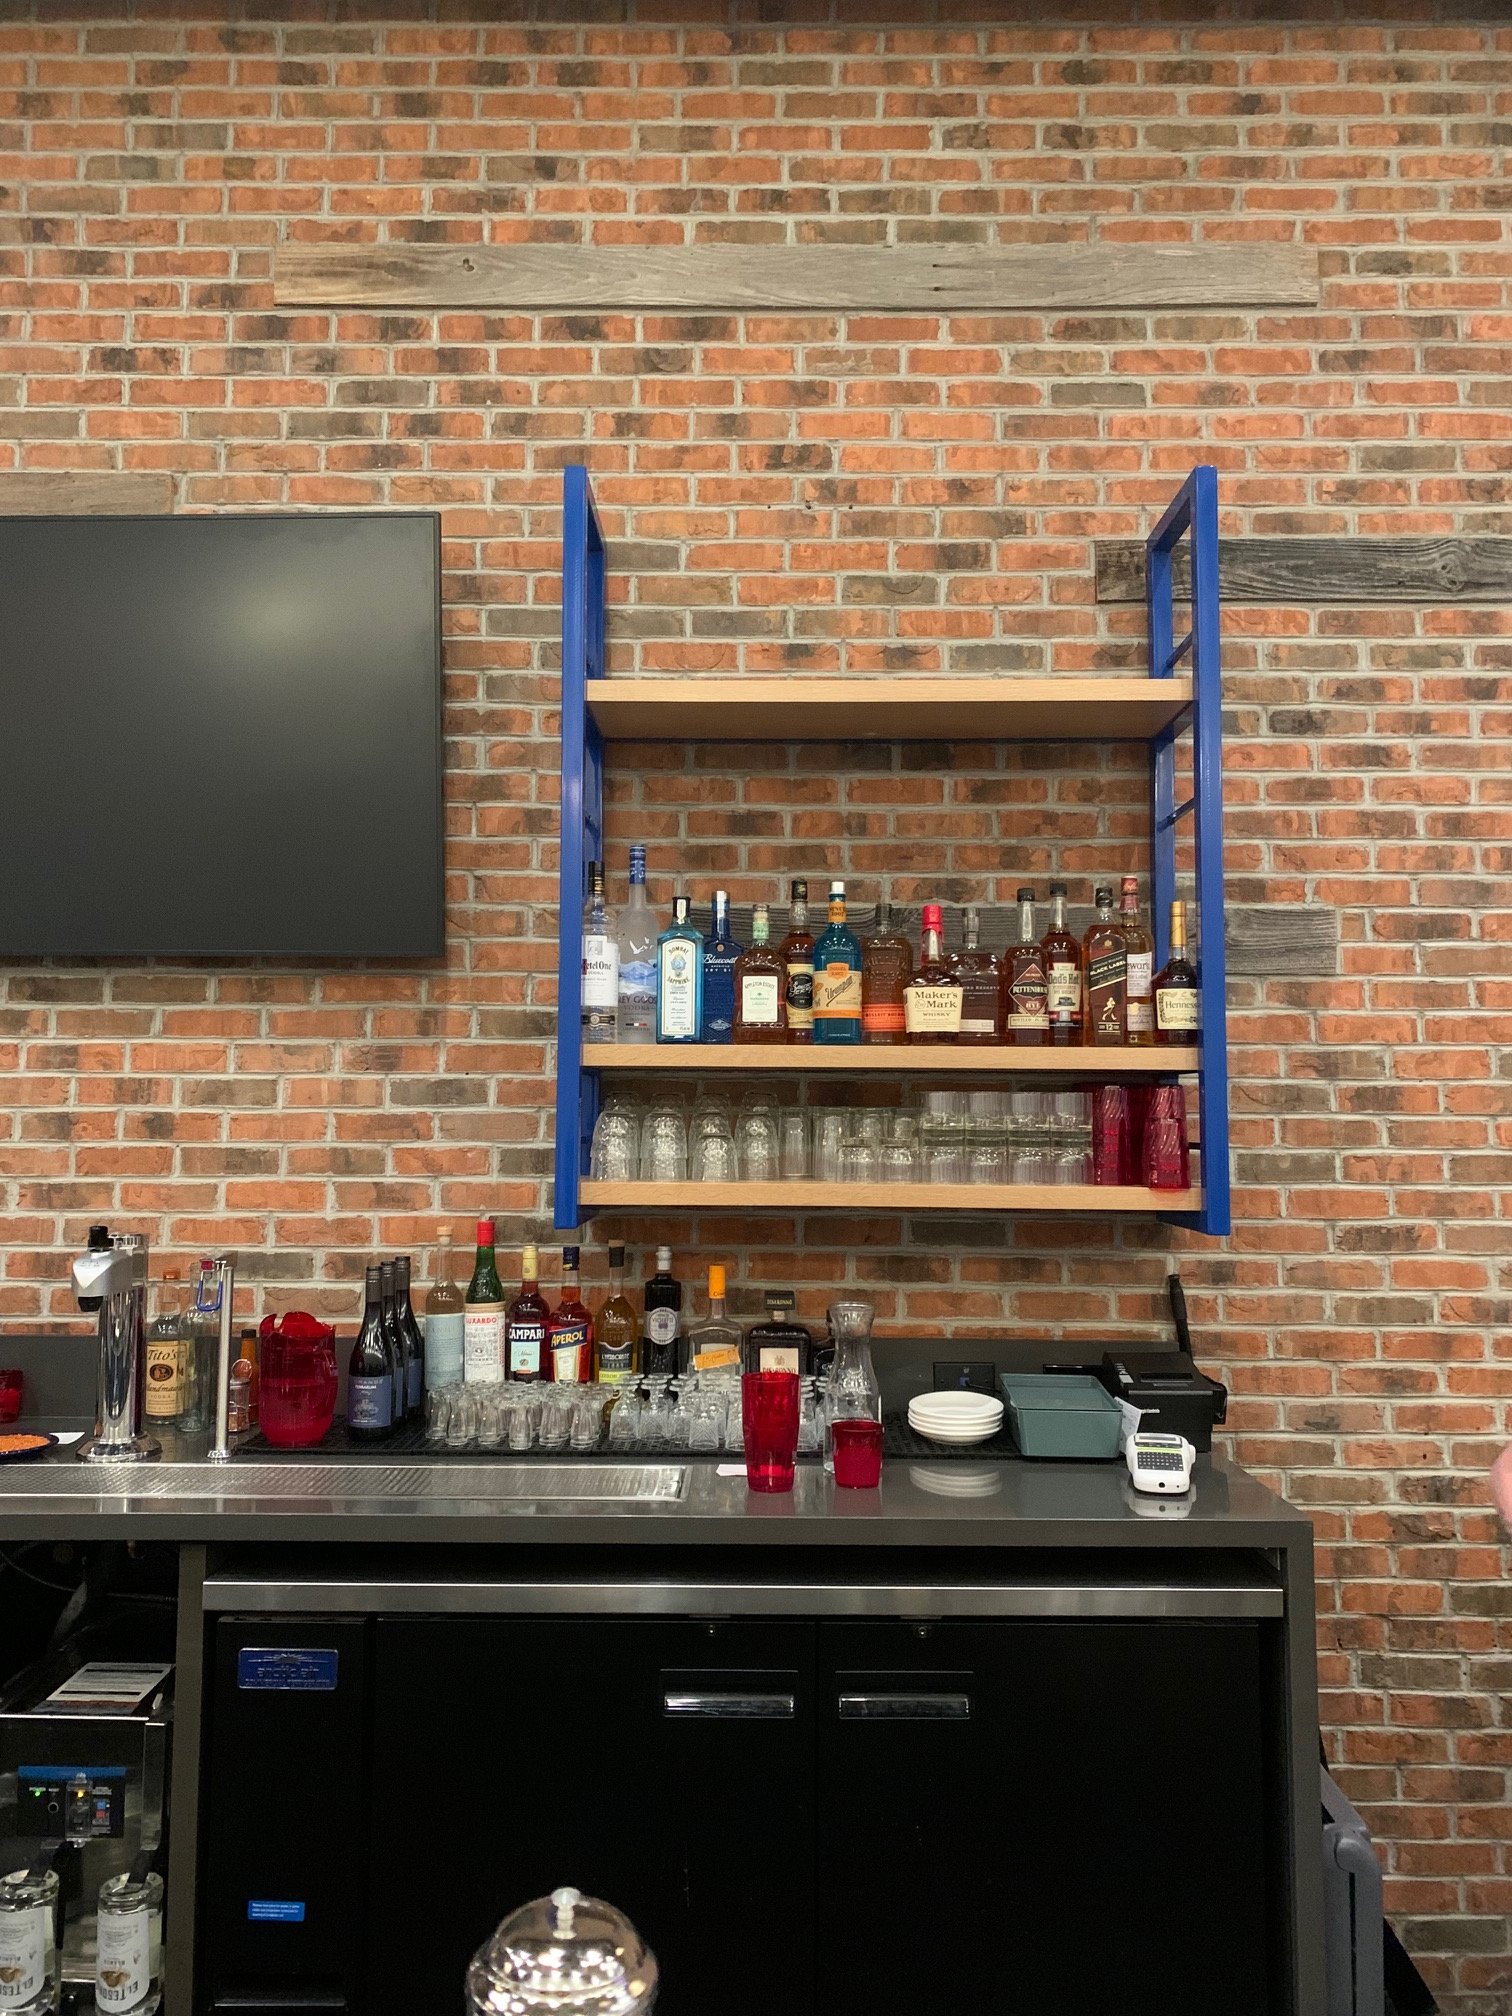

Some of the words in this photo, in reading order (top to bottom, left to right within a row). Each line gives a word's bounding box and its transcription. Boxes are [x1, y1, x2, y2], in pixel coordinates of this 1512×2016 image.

[668, 946, 689, 955] BOMBAY
[703, 953, 738, 963] Bluecoat
[599, 961, 612, 970] One
[1090, 966, 1109, 975] BLACK
[1109, 960, 1126, 969] LABEL
[618, 995, 630, 1004] REY
[634, 995, 657, 1004] GOOS
[915, 991, 958, 999] Maker's
[926, 1000, 957, 1008] Mark
[509, 1328, 545, 1339] CAMPARI
[551, 1331, 584, 1347] APEROL
[148, 1349, 177, 1361] Tito's
